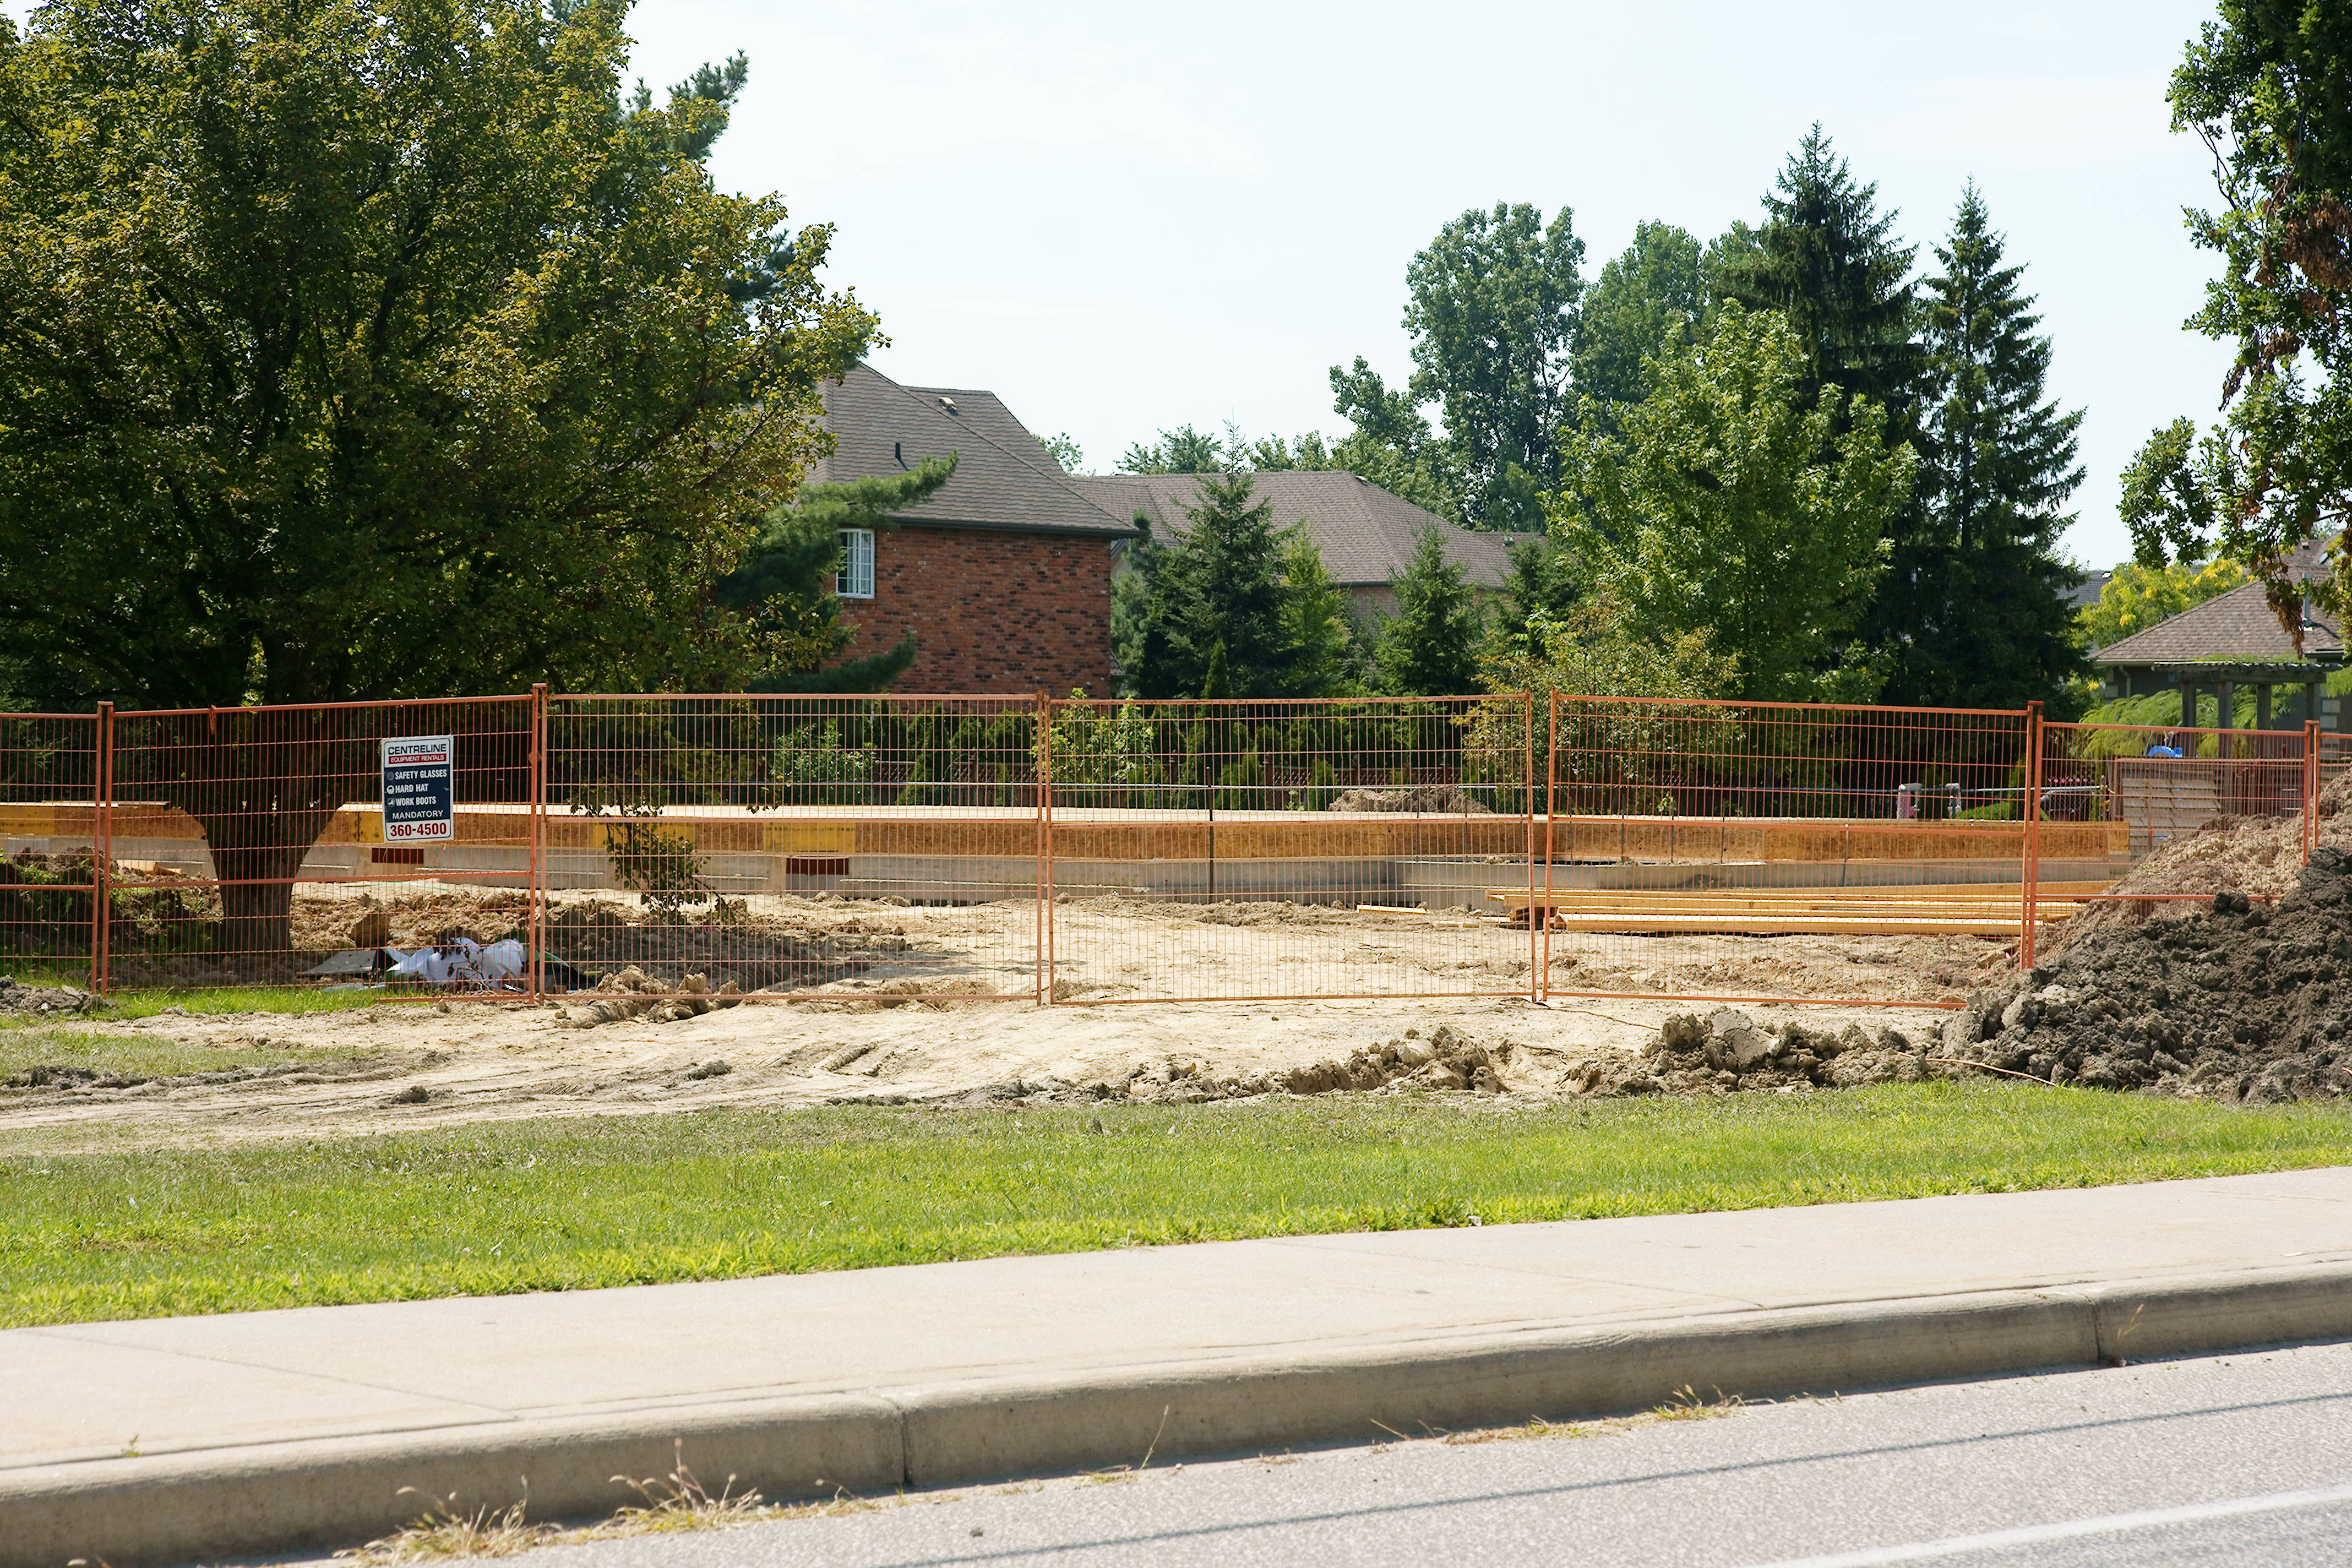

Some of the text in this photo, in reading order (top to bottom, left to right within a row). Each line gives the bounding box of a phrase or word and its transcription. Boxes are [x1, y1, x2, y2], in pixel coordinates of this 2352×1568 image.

[388, 744, 447, 755] CENTRELINE
[395, 769, 447, 780] SAFETY GLASSES
[395, 783, 429, 793] HARD HAT
[396, 797, 436, 806] WORK BOOTS
[393, 810, 443, 819] MANDATORY
[390, 823, 447, 837] 360-4500
